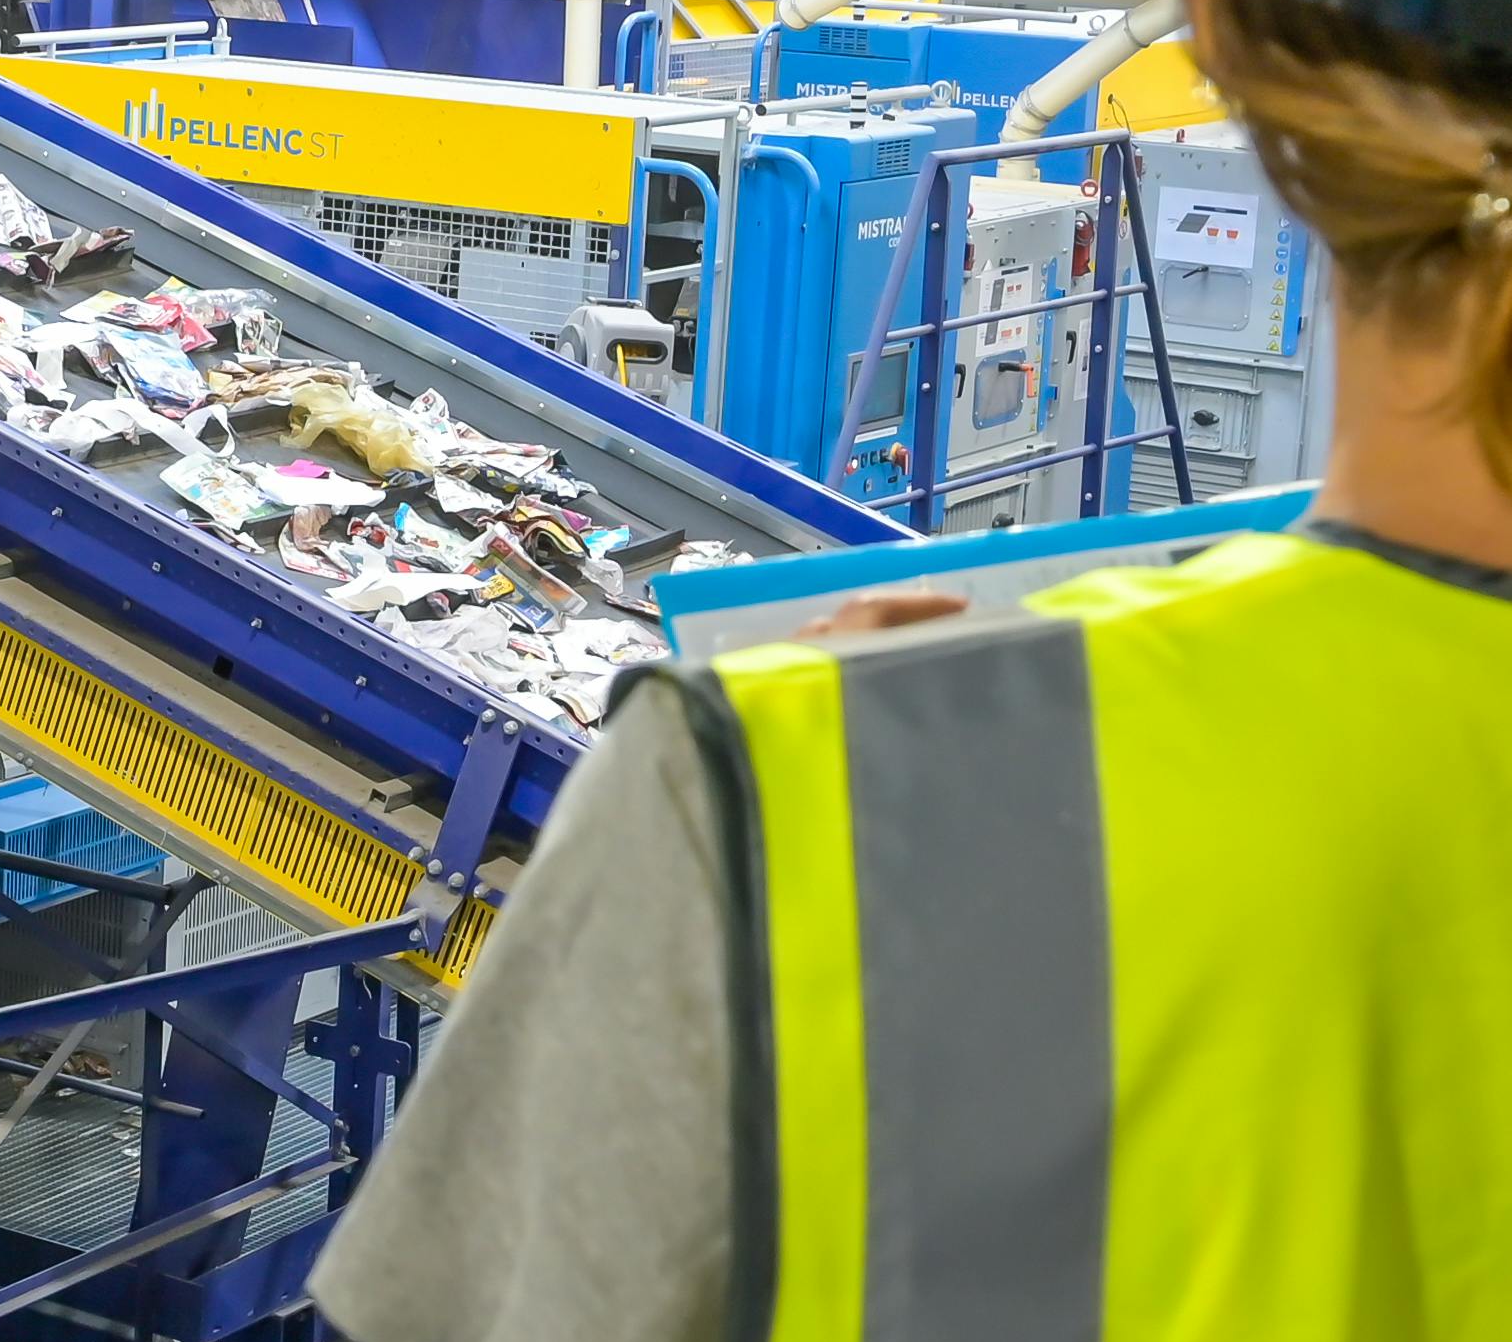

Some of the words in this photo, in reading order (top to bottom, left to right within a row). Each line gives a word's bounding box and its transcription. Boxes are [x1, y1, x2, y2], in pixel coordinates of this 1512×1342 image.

[962, 93, 1019, 108] PELLEN
[170, 117, 303, 155] PELLENC
[309, 132, 344, 159] ST
